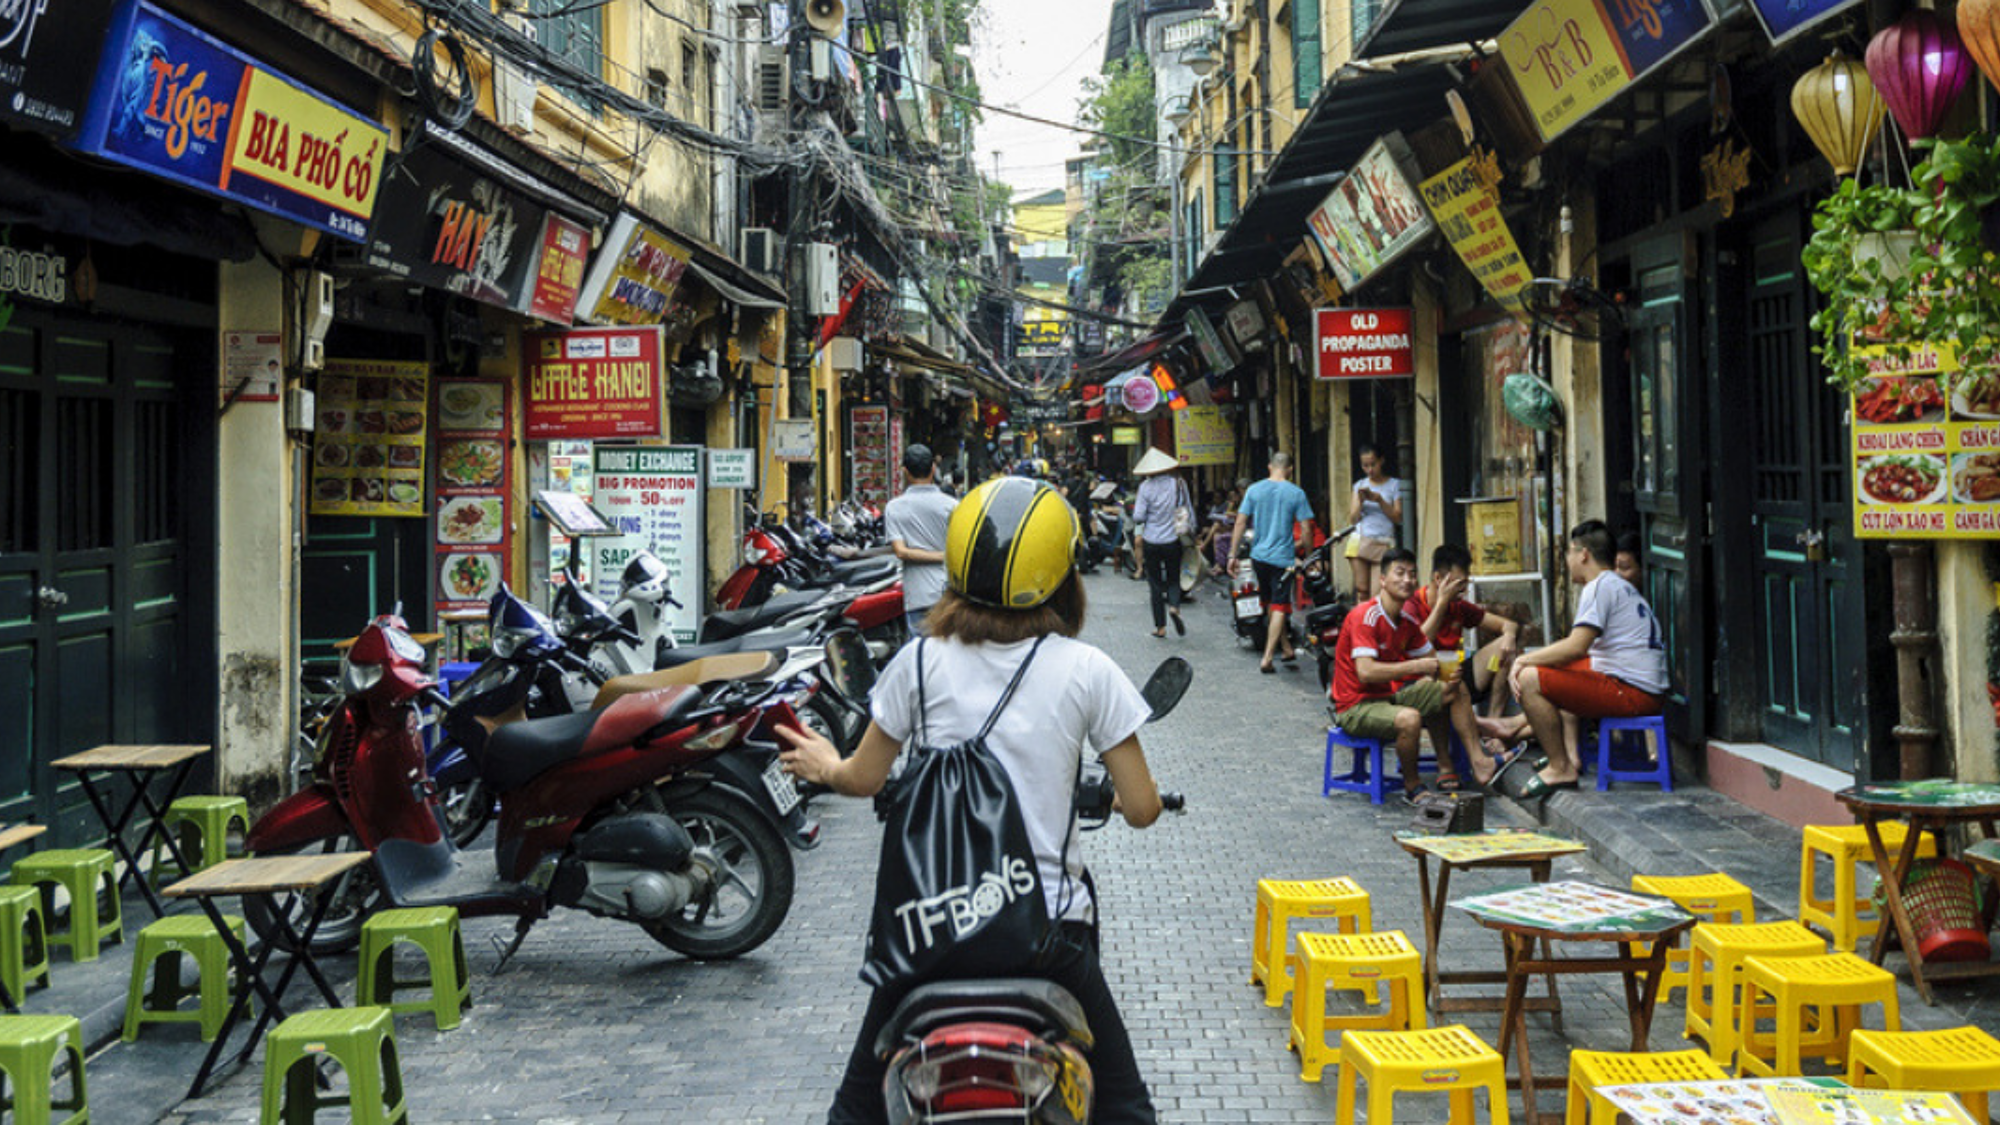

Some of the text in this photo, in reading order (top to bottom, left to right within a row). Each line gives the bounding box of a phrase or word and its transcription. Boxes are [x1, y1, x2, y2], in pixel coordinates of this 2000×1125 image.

[144, 56, 228, 158] Tiger
[244, 109, 290, 172] BIA
[293, 128, 348, 190] PHỐ
[432, 200, 493, 273] HAY
[0, 245, 66, 303] BORG
[1351, 314, 1378, 329] OLD
[1322, 333, 1411, 352] PROPAGANDA
[1341, 355, 1392, 372] POSTER
[531, 361, 651, 401] LITTLE HANOI
[1857, 433, 1888, 450] KHOAI
[1888, 432, 1914, 449] LANG
[598, 451, 638, 471] MONEY
[639, 450, 697, 471] EXCHANGE
[598, 477, 696, 489] BIG PROMOTION
